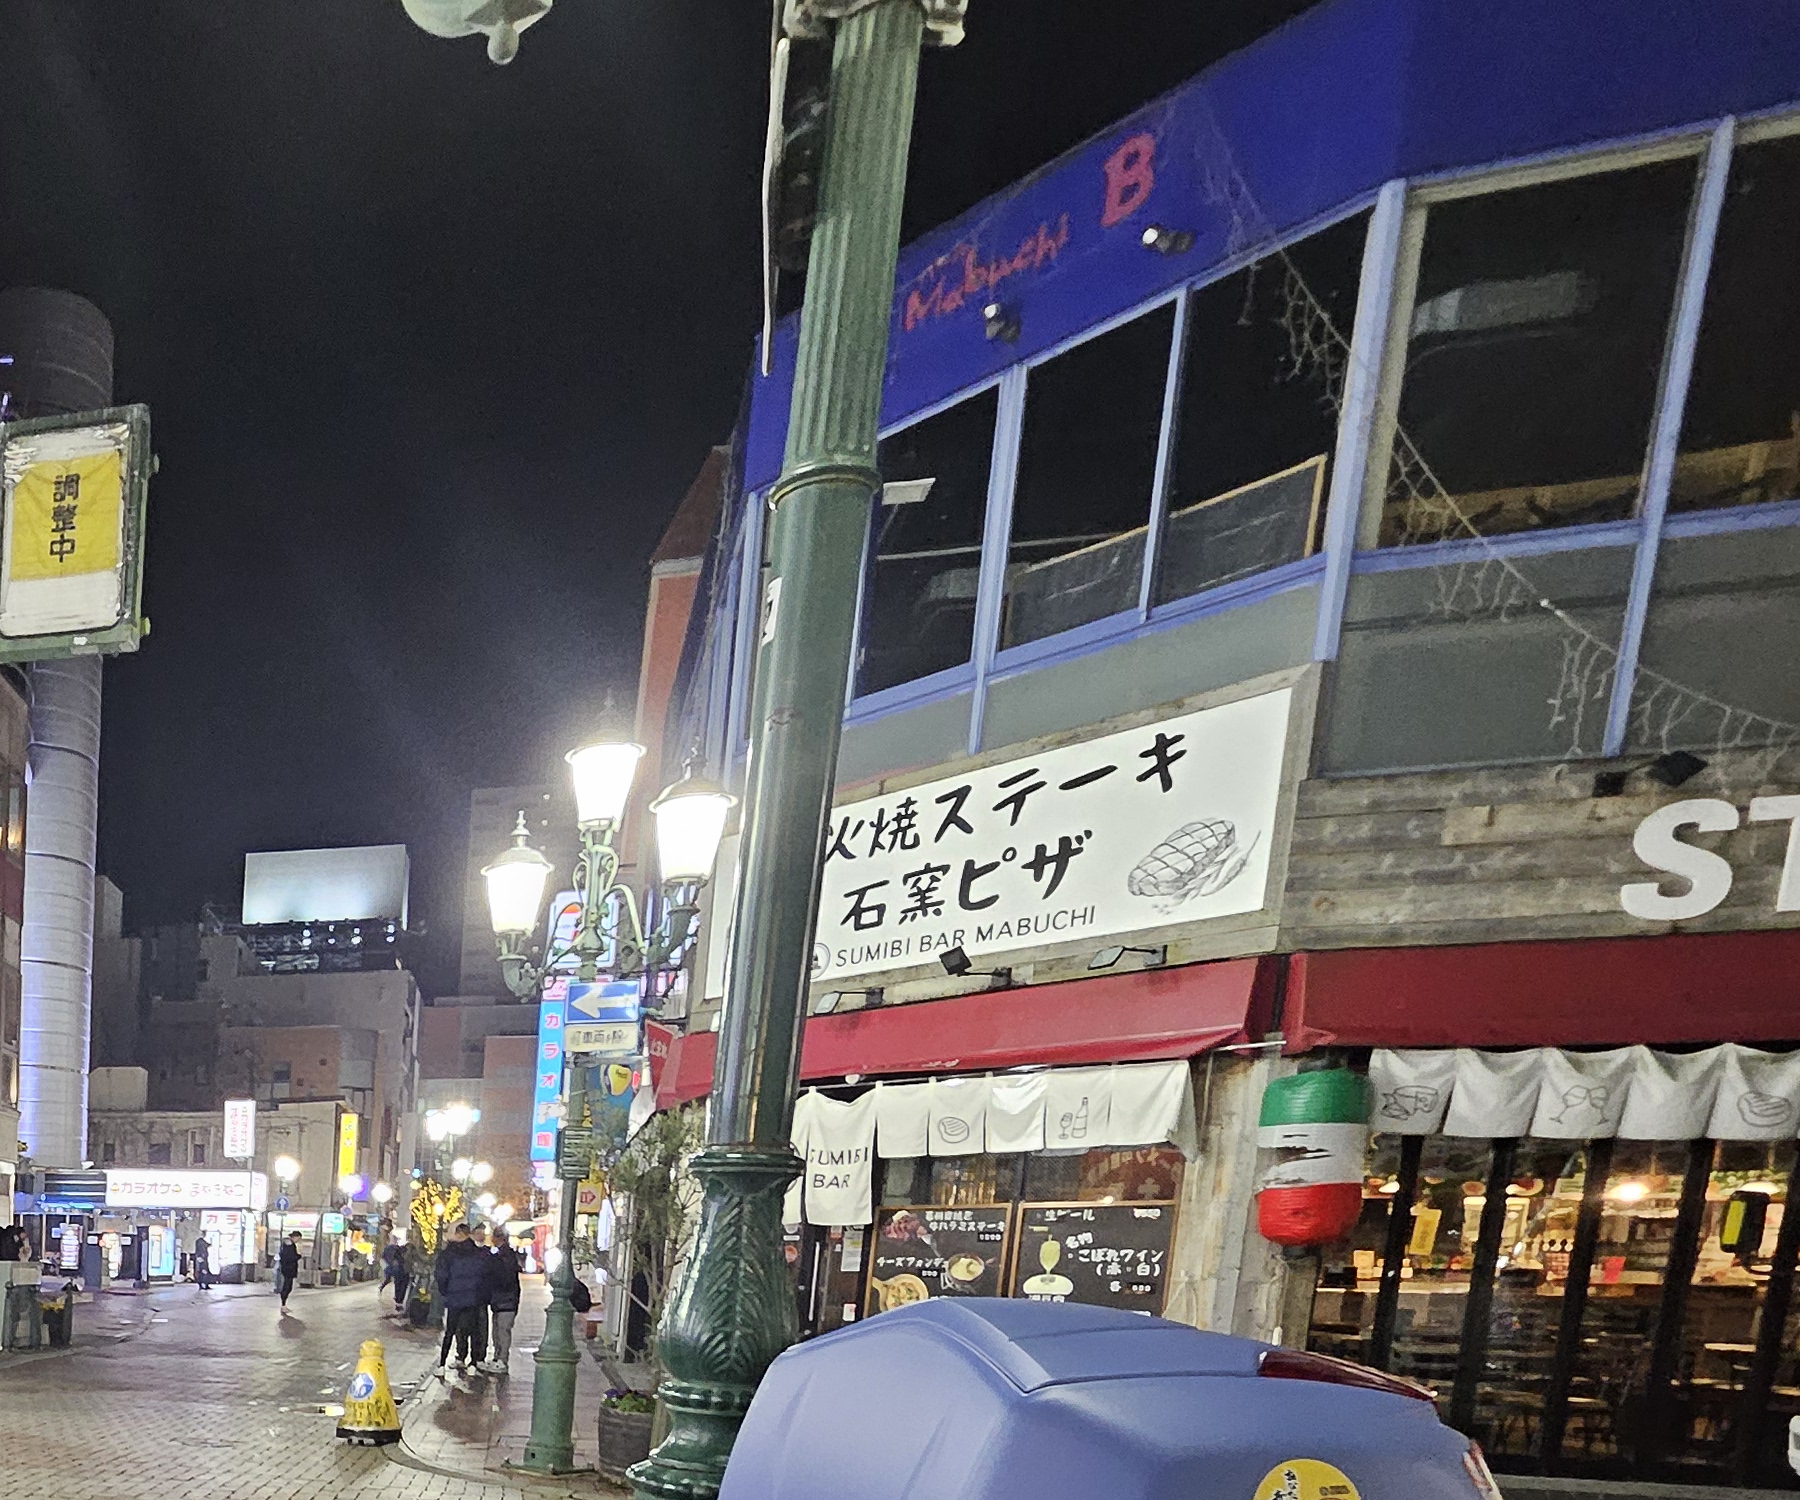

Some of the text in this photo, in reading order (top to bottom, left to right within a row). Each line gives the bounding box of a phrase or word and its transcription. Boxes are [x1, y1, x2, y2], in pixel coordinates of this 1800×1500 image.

[1101, 132, 1156, 227] B
[50, 473, 80, 563] 調整中
[840, 829, 1094, 932] 石窯ピザ
[836, 905, 1096, 968] SUMIBI BAR MABUCHI
[809, 1147, 868, 1166] SUMIBI
[813, 1173, 850, 1189] BAR
[121, 1182, 171, 1195] カラオケ
